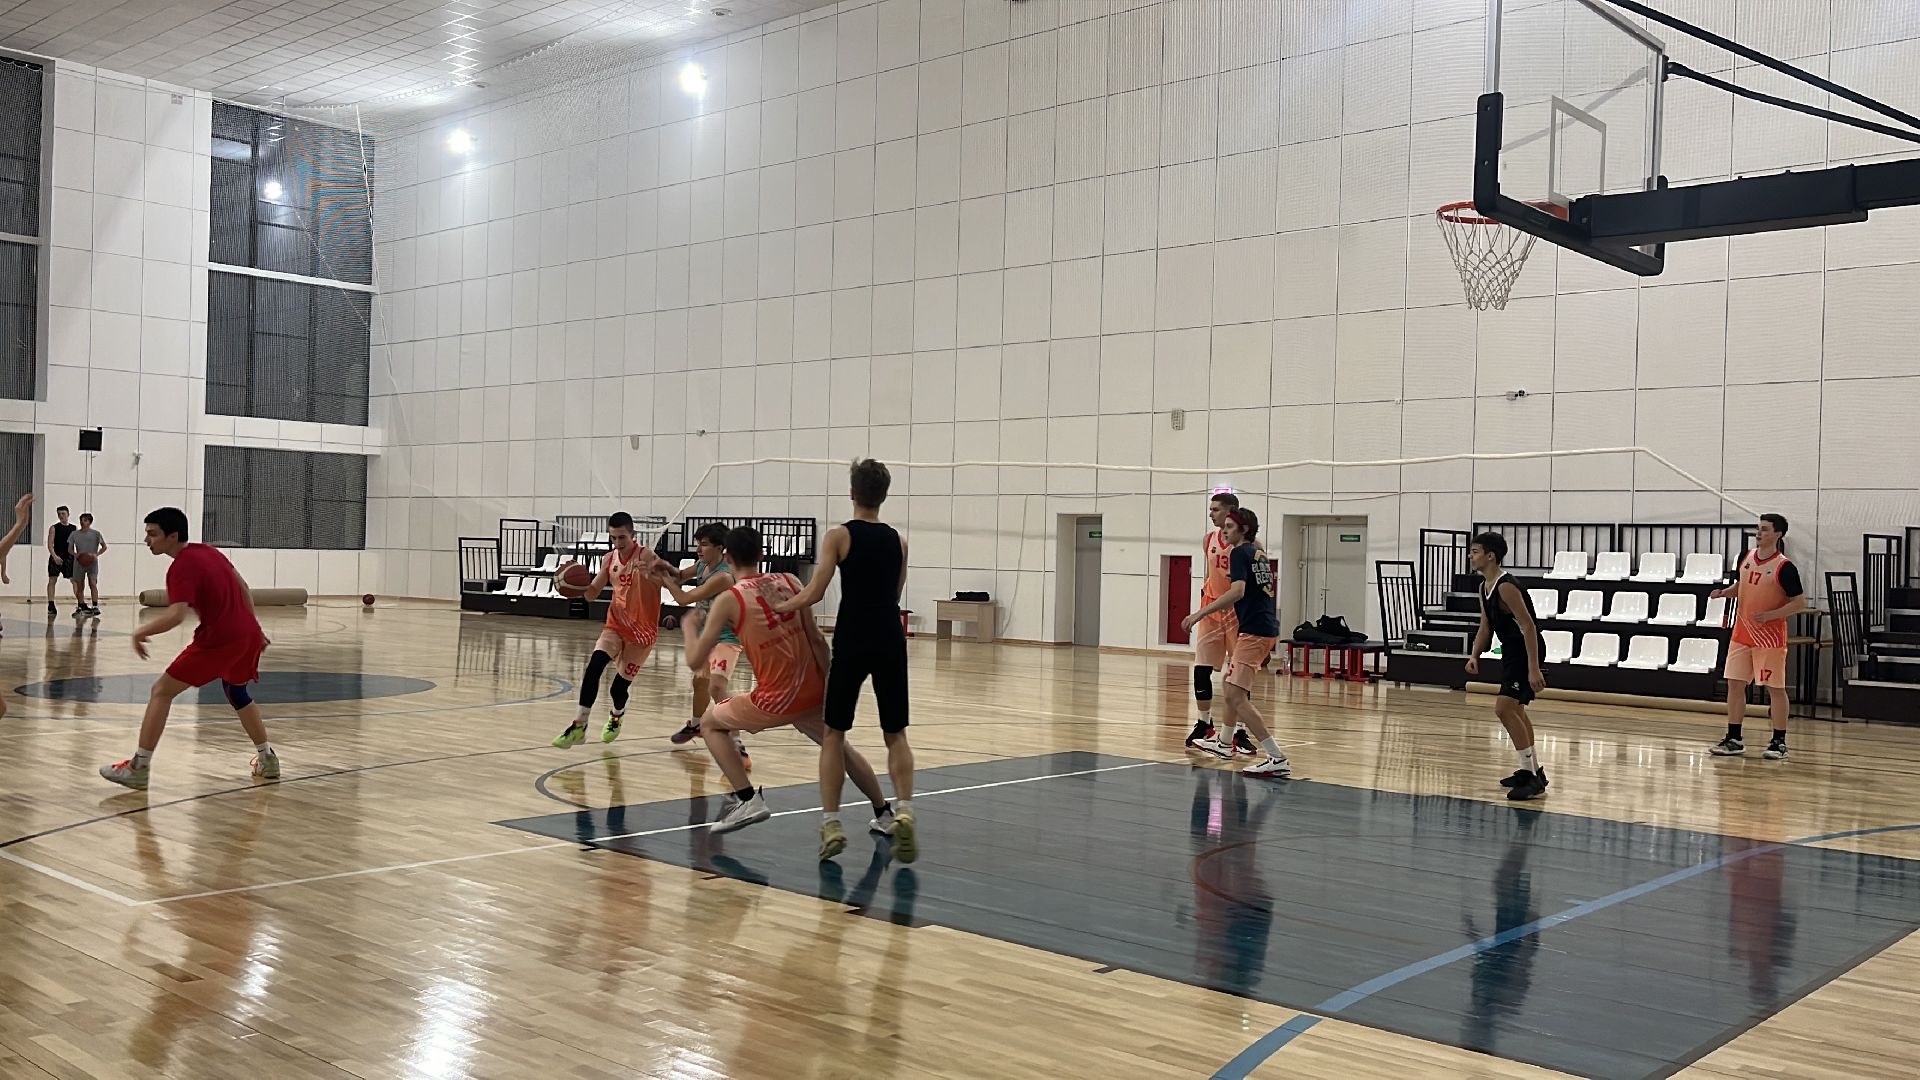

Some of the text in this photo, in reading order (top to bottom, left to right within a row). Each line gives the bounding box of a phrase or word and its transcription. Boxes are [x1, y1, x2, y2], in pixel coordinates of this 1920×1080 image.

[1215, 554, 1229, 570] 13
[1748, 571, 1762, 585] 17
[1760, 669, 1773, 682] 17
